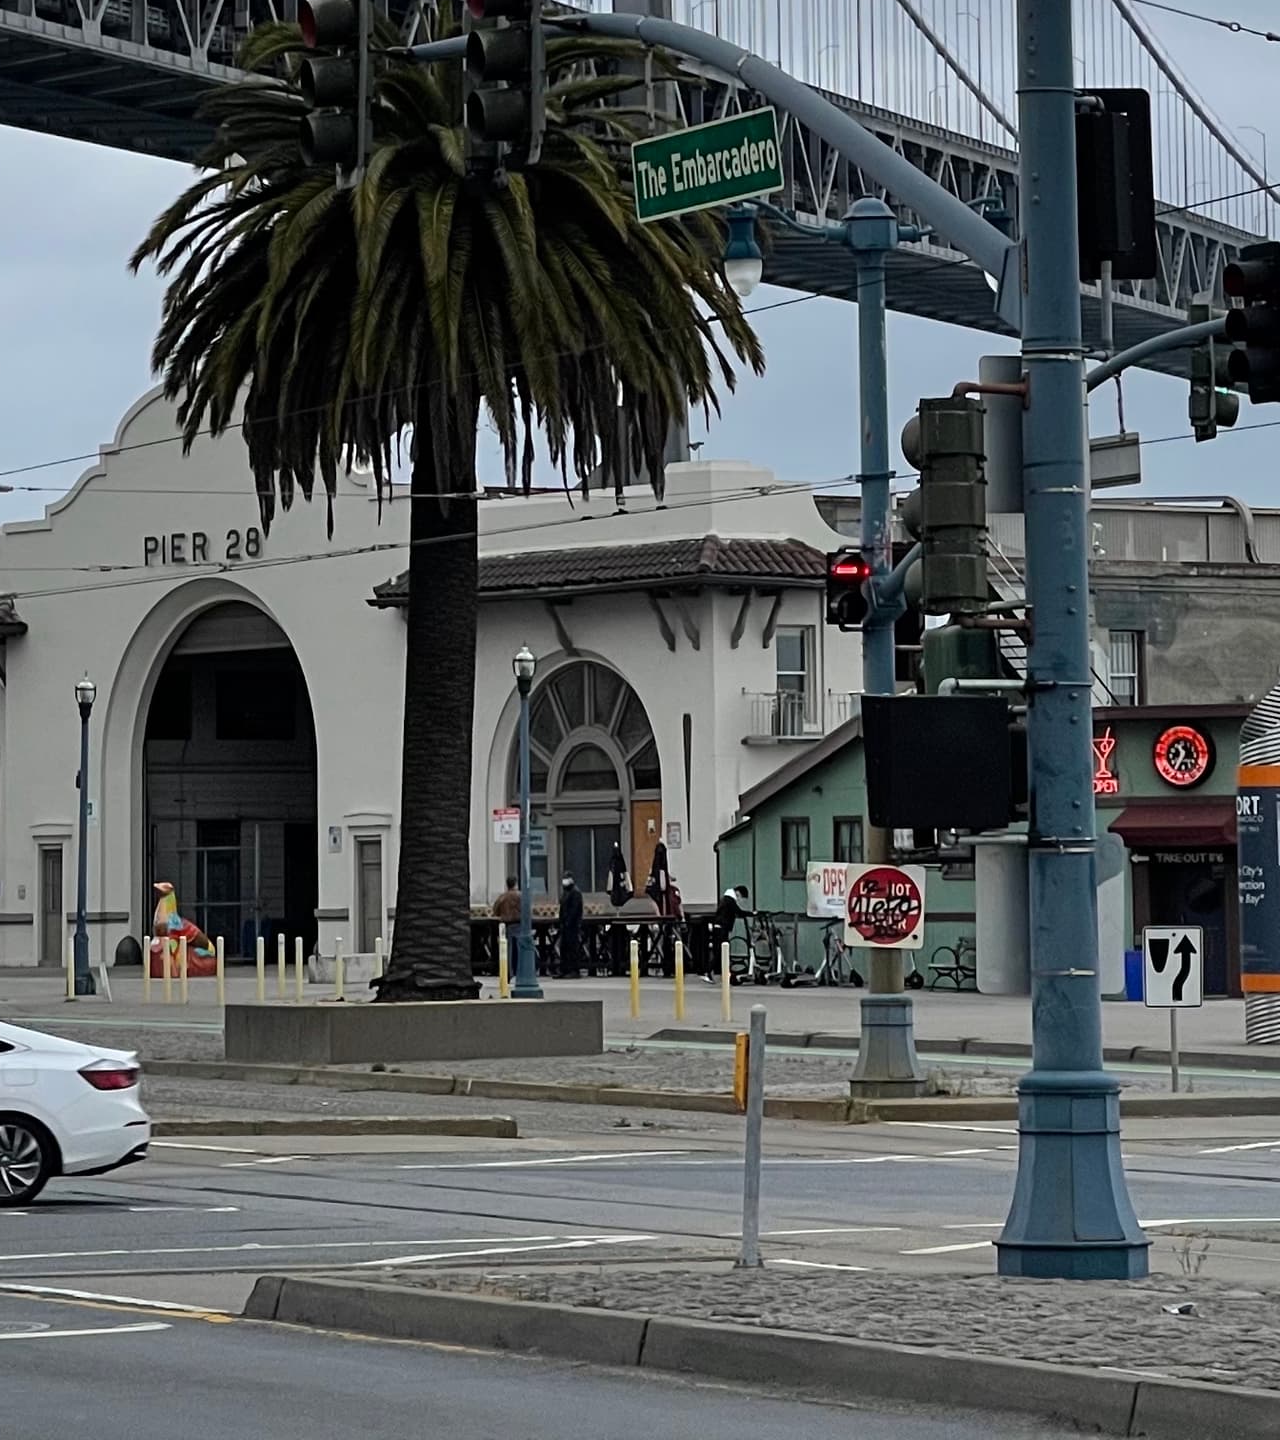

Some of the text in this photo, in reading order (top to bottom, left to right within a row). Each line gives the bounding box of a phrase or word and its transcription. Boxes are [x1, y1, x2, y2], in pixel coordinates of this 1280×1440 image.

[638, 137, 777, 200] The Embarcadero
[144, 527, 261, 567] PIER 28
